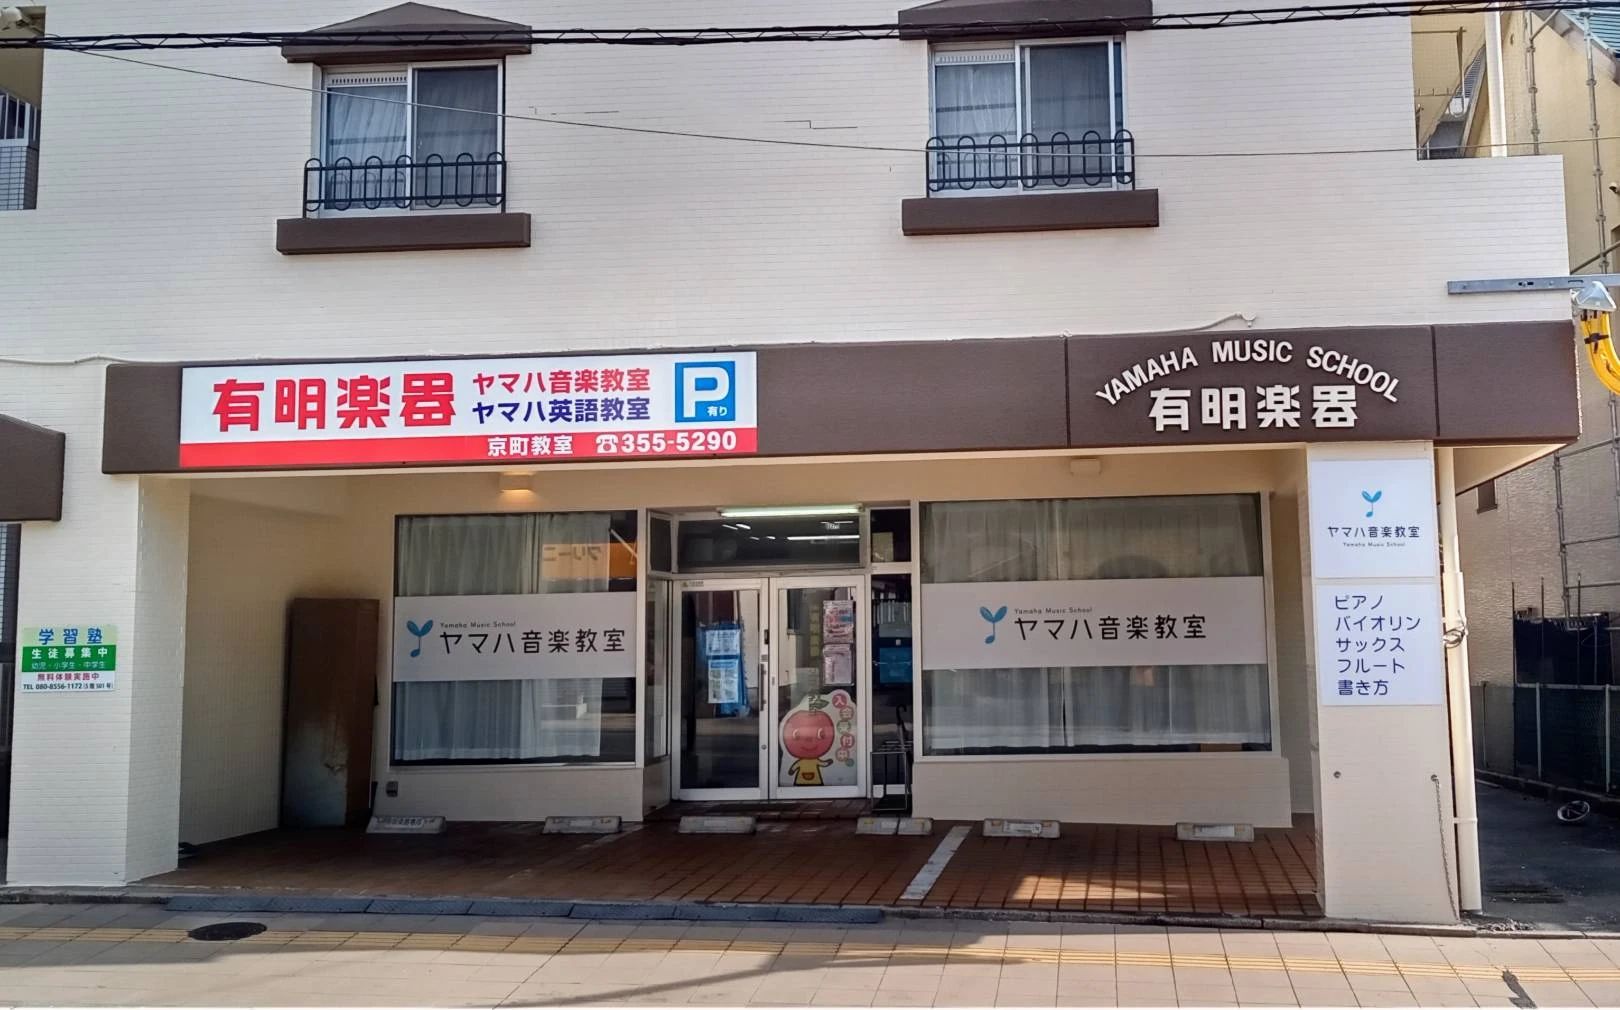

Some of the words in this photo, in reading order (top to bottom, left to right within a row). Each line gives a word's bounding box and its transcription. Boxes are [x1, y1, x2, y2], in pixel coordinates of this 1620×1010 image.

[1095, 346, 1199, 406] YAMAHA
[1211, 338, 1293, 363] MUSIC
[1306, 346, 1400, 403] SCHOOL
[472, 367, 651, 396] ヤマハ音楽教室
[682, 366, 730, 418] P
[212, 372, 457, 433] 有明楽器
[471, 396, 652, 425] ヤマハ英語教室
[706, 405, 728, 417] 有り
[1148, 384, 1359, 432] 有明楽器
[487, 434, 574, 457] 京町教室
[621, 430, 737, 454] 355-5290
[1327, 525, 1421, 538] ヤマハ音楽教室
[1335, 594, 1384, 610] ピアノ
[493, 620, 516, 628] School
[1013, 614, 1207, 640] ヤマハ音楽教室
[1335, 615, 1421, 632] バイオリン
[38, 627, 103, 645] 学習塾
[439, 628, 626, 654] ヤマハ音楽教室
[1335, 636, 1405, 653] サックス
[31, 647, 108, 659] 生徒募集中
[1337, 658, 1405, 674] フルート
[37, 672, 100, 681] 無料体験実施中
[1338, 679, 1389, 696] 書き方
